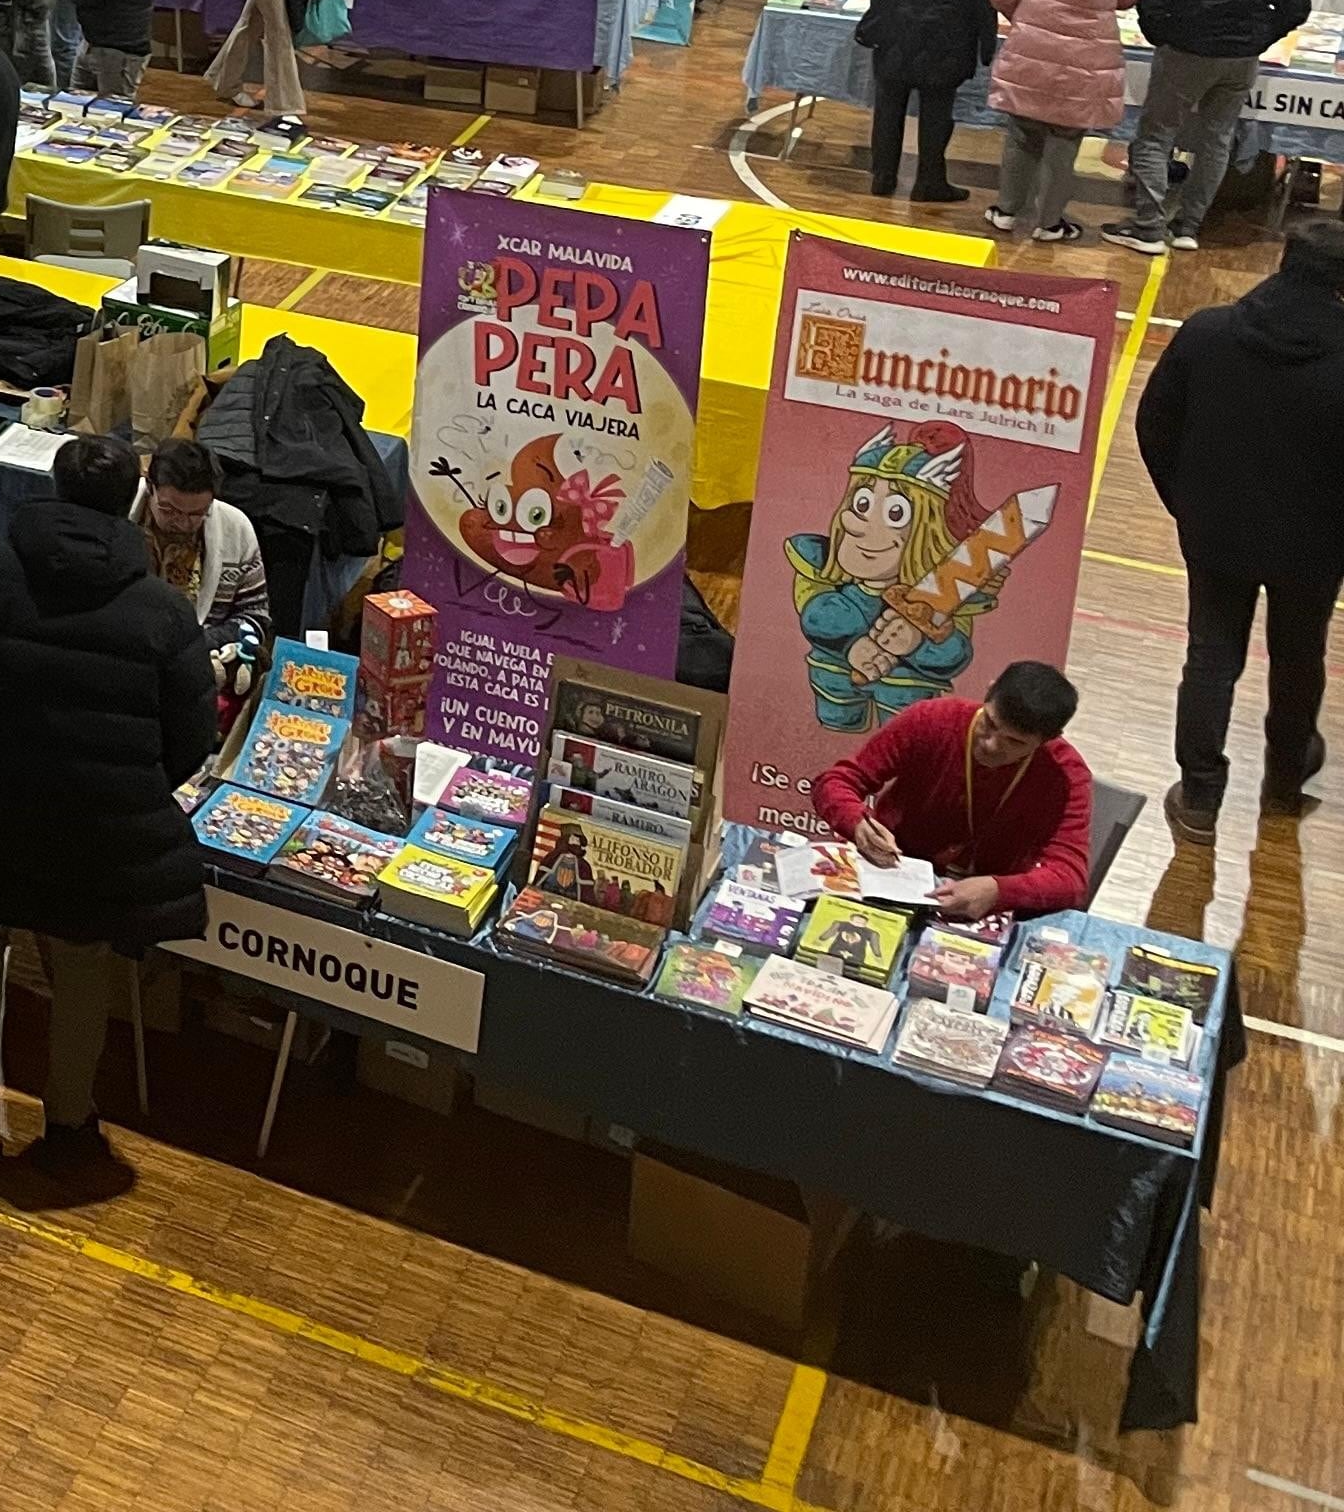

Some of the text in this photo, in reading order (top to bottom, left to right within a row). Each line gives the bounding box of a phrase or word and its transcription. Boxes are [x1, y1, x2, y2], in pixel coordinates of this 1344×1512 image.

[1274, 93, 1312, 116] SIN
[498, 234, 634, 274] XCAR MALAVIDA
[491, 256, 662, 348] PEPA
[842, 266, 1060, 314] www.editorialcornoque.com
[474, 321, 642, 414] PERA
[477, 391, 641, 441] LA CACA VIAJERA
[835, 385, 857, 400] La
[863, 390, 902, 410] saga
[909, 396, 929, 412] de
[936, 402, 975, 421] Lars
[446, 642, 549, 678] QUE NAVEGA EN
[460, 630, 495, 650] IGUAL
[502, 640, 541, 662] VUELA
[484, 682, 519, 702] CACA
[524, 693, 539, 707] ES
[497, 670, 506, 683] A
[512, 674, 544, 693] PATA
[440, 696, 539, 736] ¡UN CUENTO
[443, 716, 455, 734] Y
[461, 721, 483, 741] EN
[605, 702, 689, 736] PETRONILA
[614, 761, 666, 784] RAMIRO
[217, 922, 420, 1011] CORNOQUE
